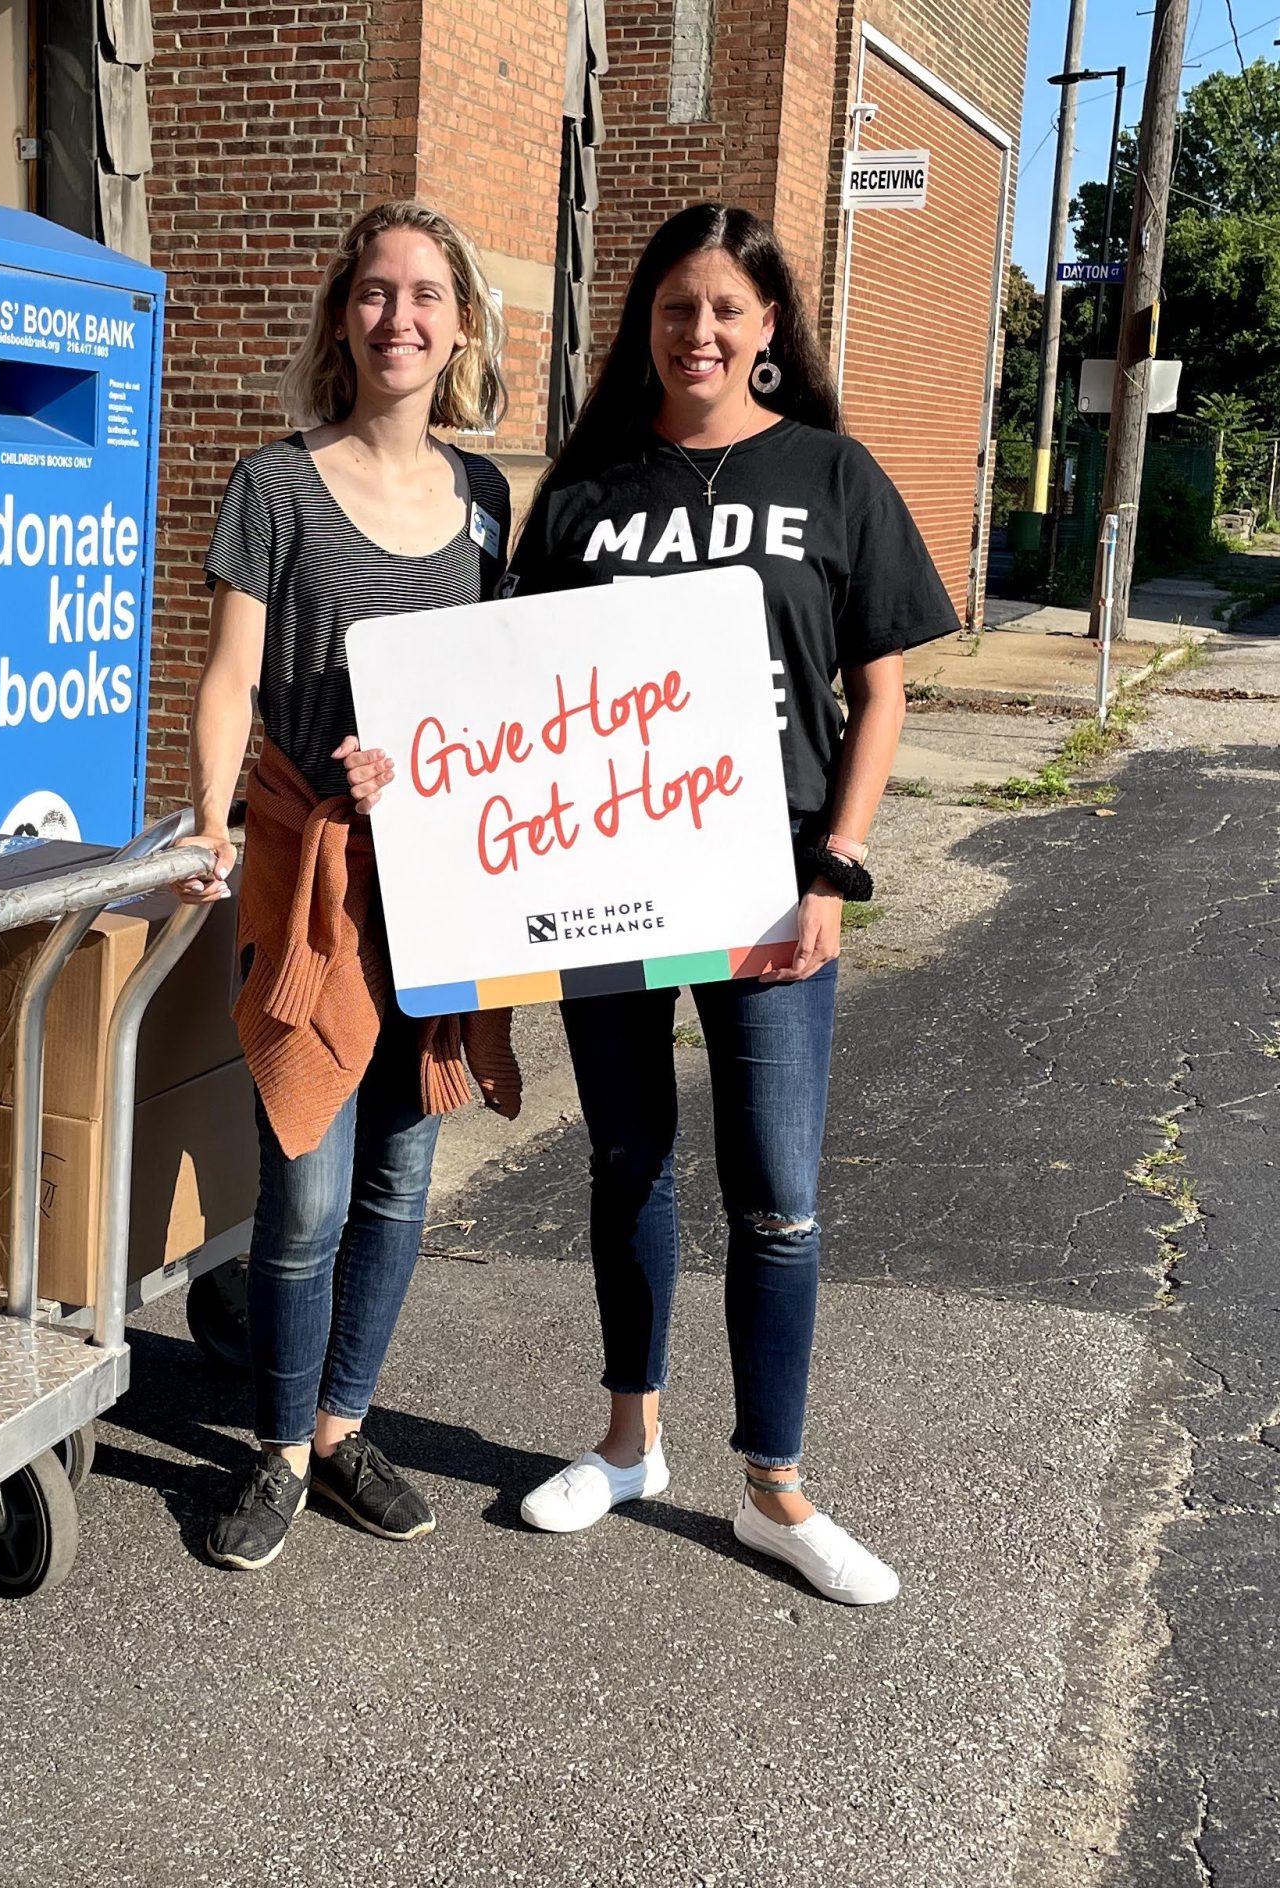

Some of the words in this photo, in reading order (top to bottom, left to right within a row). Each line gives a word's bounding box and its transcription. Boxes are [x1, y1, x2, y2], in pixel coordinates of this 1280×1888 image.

[850, 169, 925, 190] RECEIVING
[1062, 264, 1109, 280] DAYTON
[1110, 267, 1120, 276] CT
[23, 304, 81, 340] BOOK
[85, 314, 135, 349] BANK
[0, 452, 46, 466] CHILDREN'S
[47, 454, 72, 468] BOOKS
[74, 456, 93, 469] ONLY
[582, 503, 808, 563] MADE
[48, 574, 136, 644] kids
[411, 716, 533, 797] Give
[541, 666, 691, 755] Hope
[477, 782, 580, 875] Get
[593, 750, 743, 839] Hope
[560, 908, 596, 922] THE
[604, 900, 654, 917] HOPE
[564, 916, 665, 939] EXCHANGE
